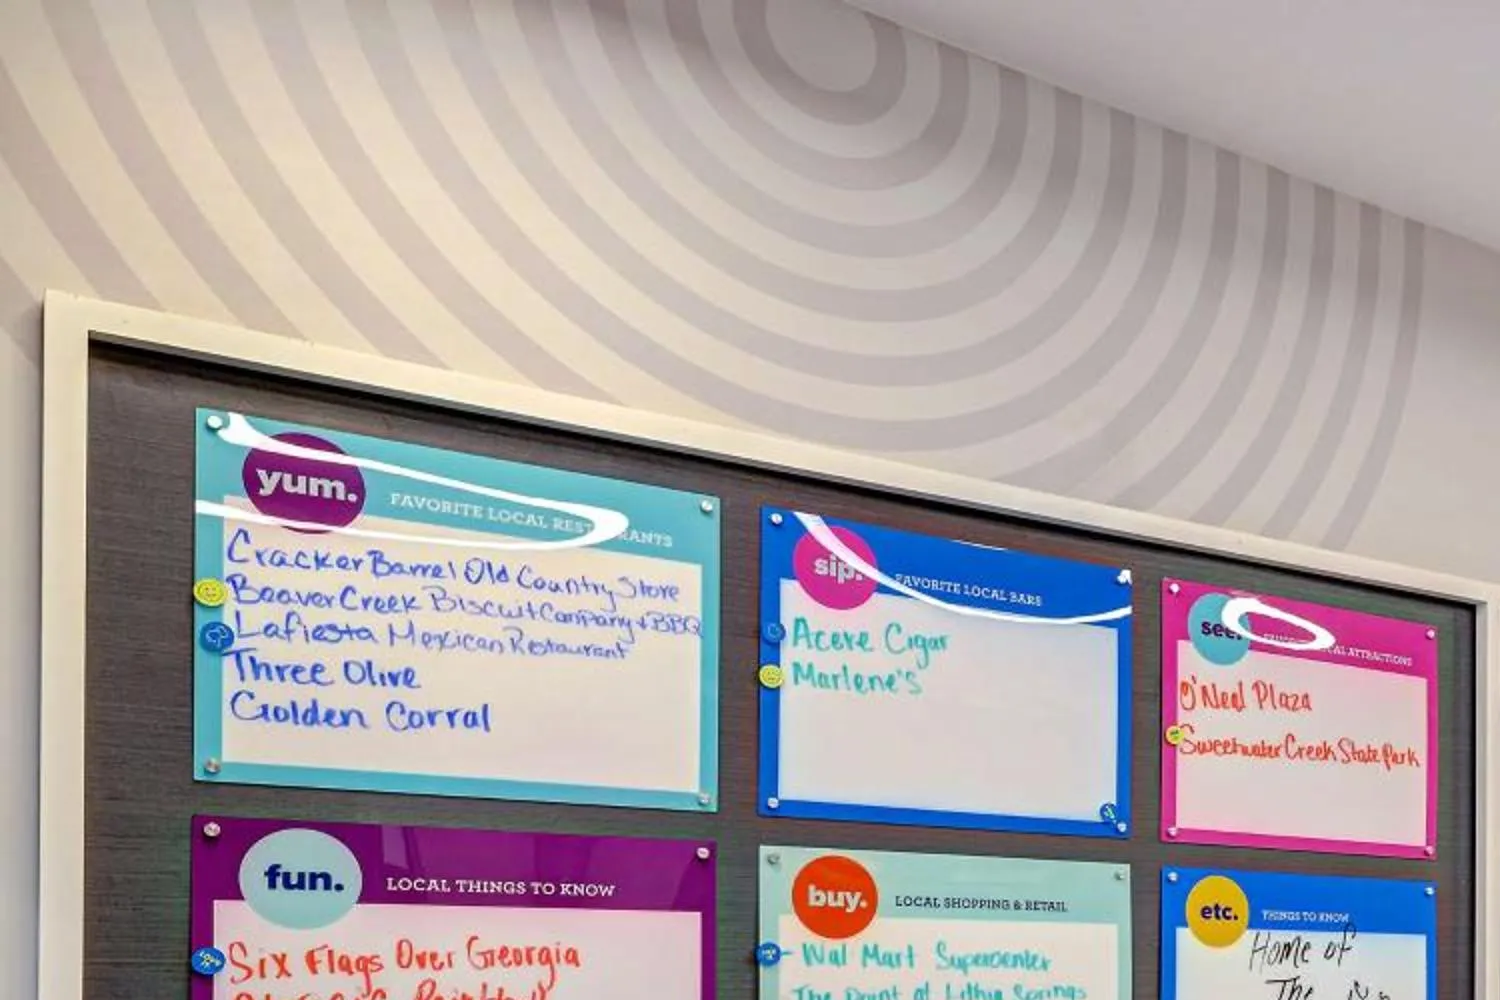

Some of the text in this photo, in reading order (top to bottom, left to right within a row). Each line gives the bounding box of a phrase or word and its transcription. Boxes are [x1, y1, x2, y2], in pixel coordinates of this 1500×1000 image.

[256, 466, 358, 503] yum.
[391, 493, 482, 520] FAVORITE
[489, 508, 548, 530] LOCAL
[228, 528, 680, 614] Cracker Barrel Old Country Store
[339, 585, 423, 615] Creek
[895, 573, 1043, 608] FAVORITE LOCAL BARS
[502, 626, 630, 660] Restaurant
[884, 620, 951, 669] Cigar
[220, 647, 422, 689] Three Olive
[791, 660, 924, 695] Marlene's
[230, 689, 492, 733] Golden Corral
[1252, 680, 1313, 713] Plaza
[1285, 732, 1337, 762] Creek
[1337, 737, 1380, 765] State
[1380, 743, 1421, 772] Park
[263, 862, 345, 893] fun.
[386, 876, 616, 898] LOCAL THINGS TO KNOW
[807, 883, 869, 913] buy.
[895, 895, 1069, 914] LOCAL SHOPPING & RETAIL
[1200, 903, 1240, 922] etc.
[1261, 909, 1350, 923] THINGS TO KNOW
[802, 941, 1052, 975] Wal Mart Supercenter
[1249, 921, 1358, 973] Home of
[226, 935, 582, 998] Six Flags Over Georgia
